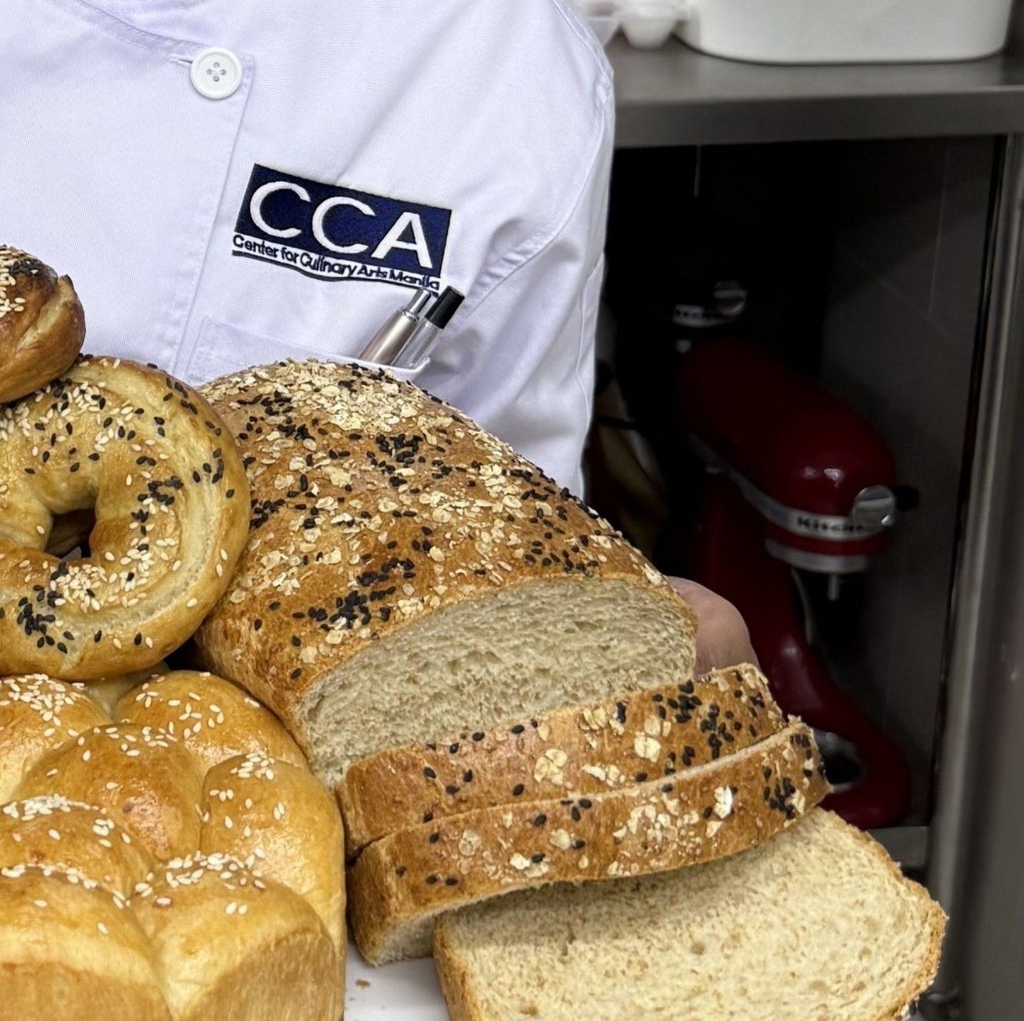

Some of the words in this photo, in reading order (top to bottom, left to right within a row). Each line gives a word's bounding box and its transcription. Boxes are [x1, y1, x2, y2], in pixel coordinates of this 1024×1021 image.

[249, 180, 433, 269] CCA
[233, 234, 279, 258] Center
[280, 246, 299, 264] for
[300, 252, 357, 278] Culinary
[357, 264, 388, 278] Arts
[389, 269, 440, 291] Manila
